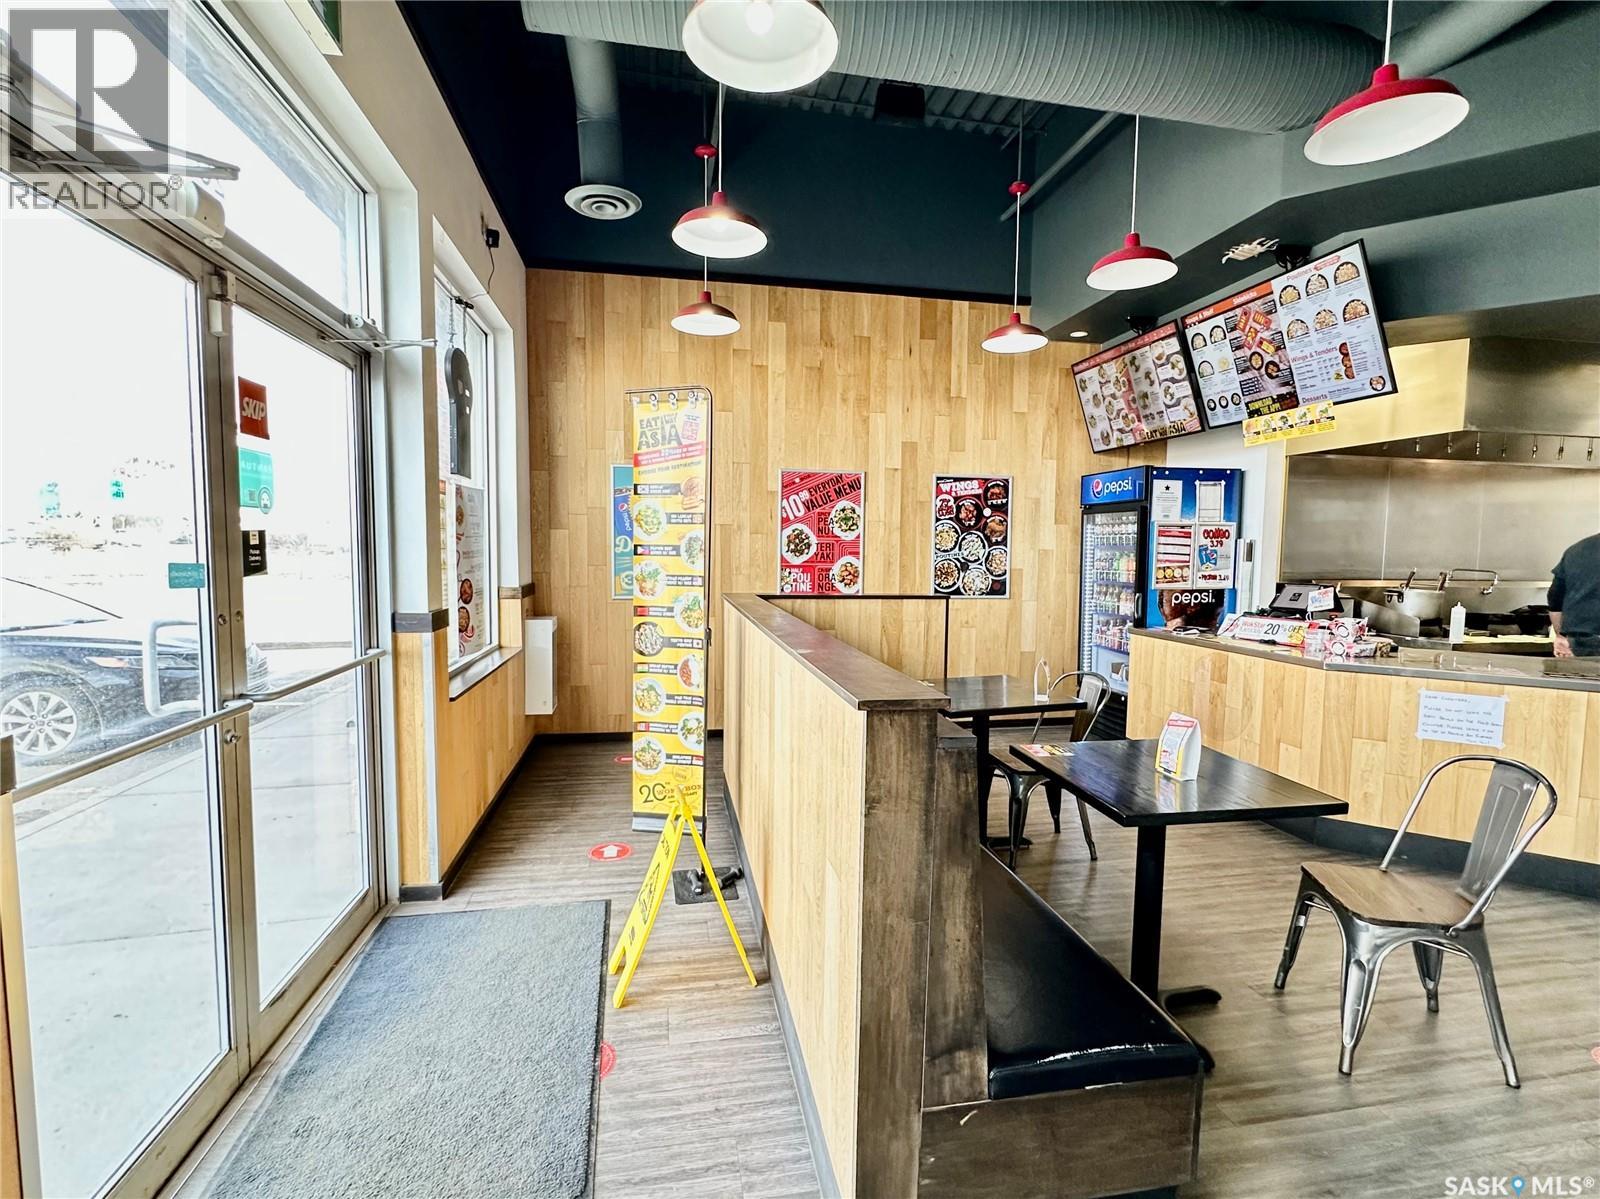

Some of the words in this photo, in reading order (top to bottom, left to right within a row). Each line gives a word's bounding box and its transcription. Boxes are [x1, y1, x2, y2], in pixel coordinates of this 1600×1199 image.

[1290, 354, 1309, 364] Wings
[1314, 345, 1338, 357] Tenders
[1301, 393, 1328, 404] Desserts
[242, 397, 266, 421] SKIP
[639, 416, 660, 430] EAT
[637, 420, 684, 451] ASIA
[808, 474, 844, 497] EVERYDAY
[939, 480, 979, 493] WINGS
[1104, 476, 1133, 496] pepsi
[803, 491, 835, 513] VALUE
[834, 477, 862, 499] MENU
[817, 517, 835, 526] PEA
[817, 526, 835, 536] NUT
[815, 542, 835, 552] TERI
[814, 552, 835, 561] YAKI
[791, 573, 811, 583] POU
[817, 573, 836, 583] ORA
[791, 582, 812, 592] TINE
[817, 582, 836, 592] NGE
